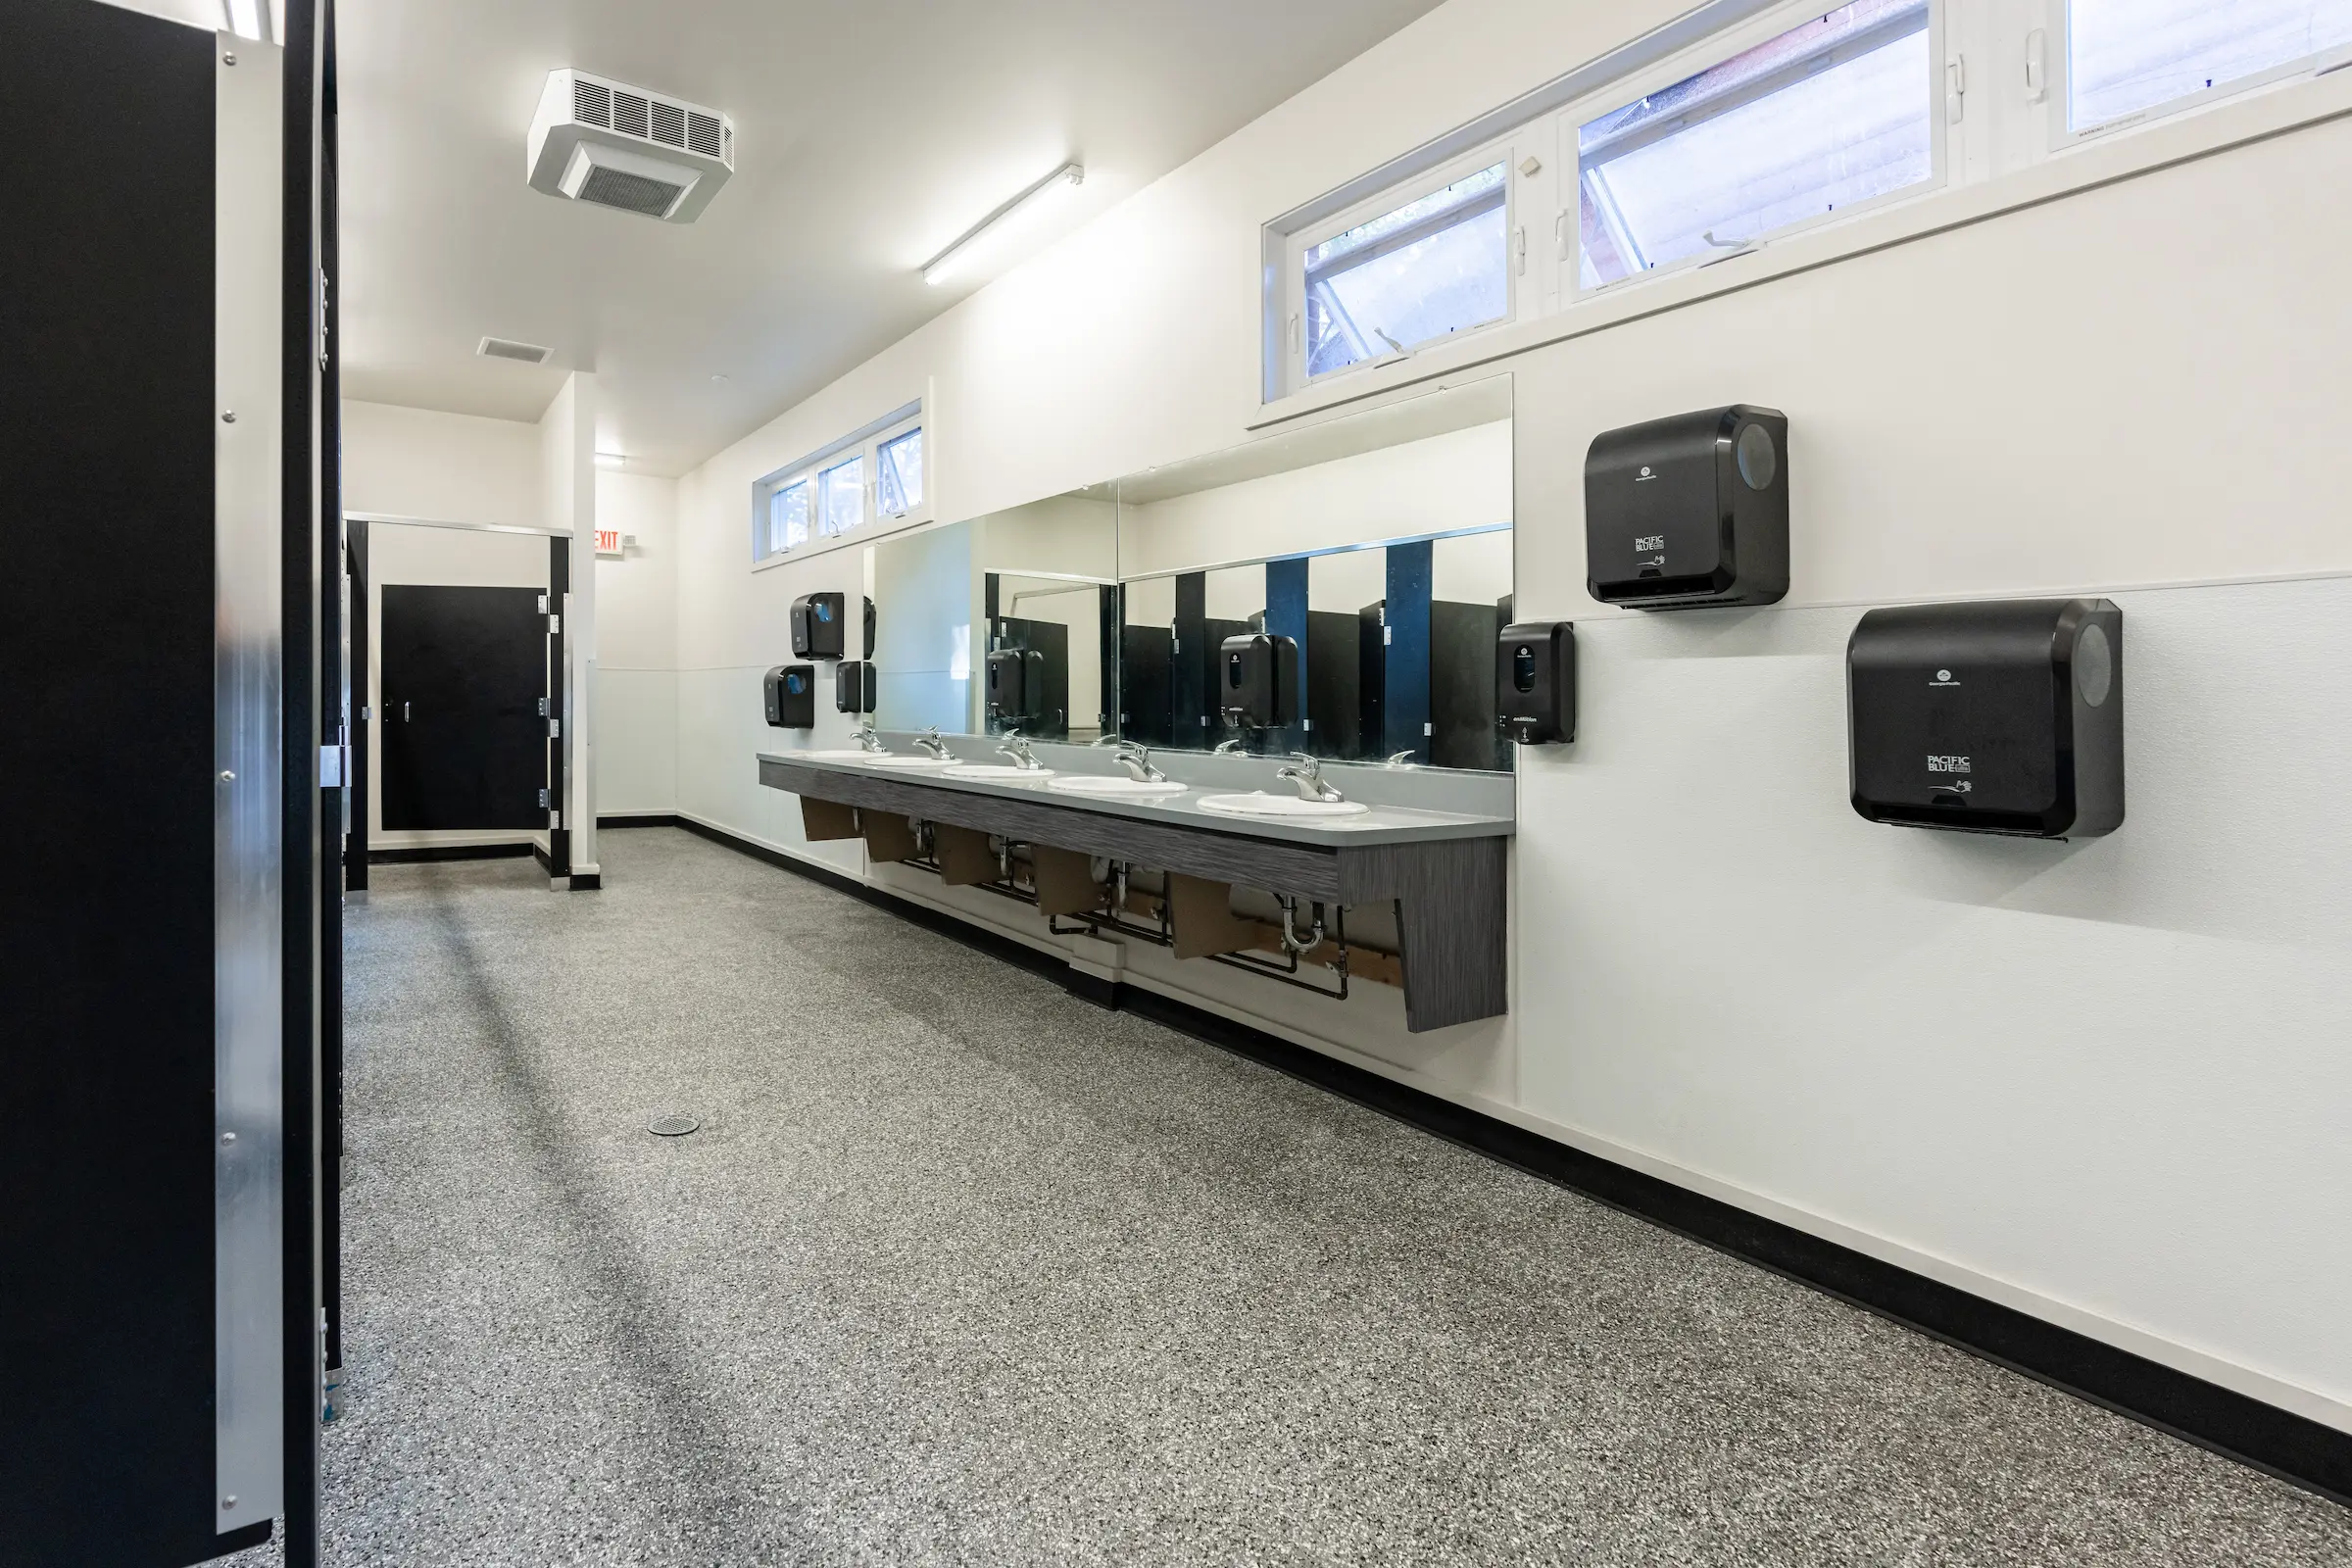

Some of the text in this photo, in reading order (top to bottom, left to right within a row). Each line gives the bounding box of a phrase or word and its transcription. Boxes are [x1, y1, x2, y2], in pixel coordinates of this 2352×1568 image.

[1636, 535, 1664, 545] PACIFIC
[1636, 543, 1654, 552] BLUE
[1928, 756, 1970, 764] PACIFIC
[1928, 762, 1955, 772] BLUE
